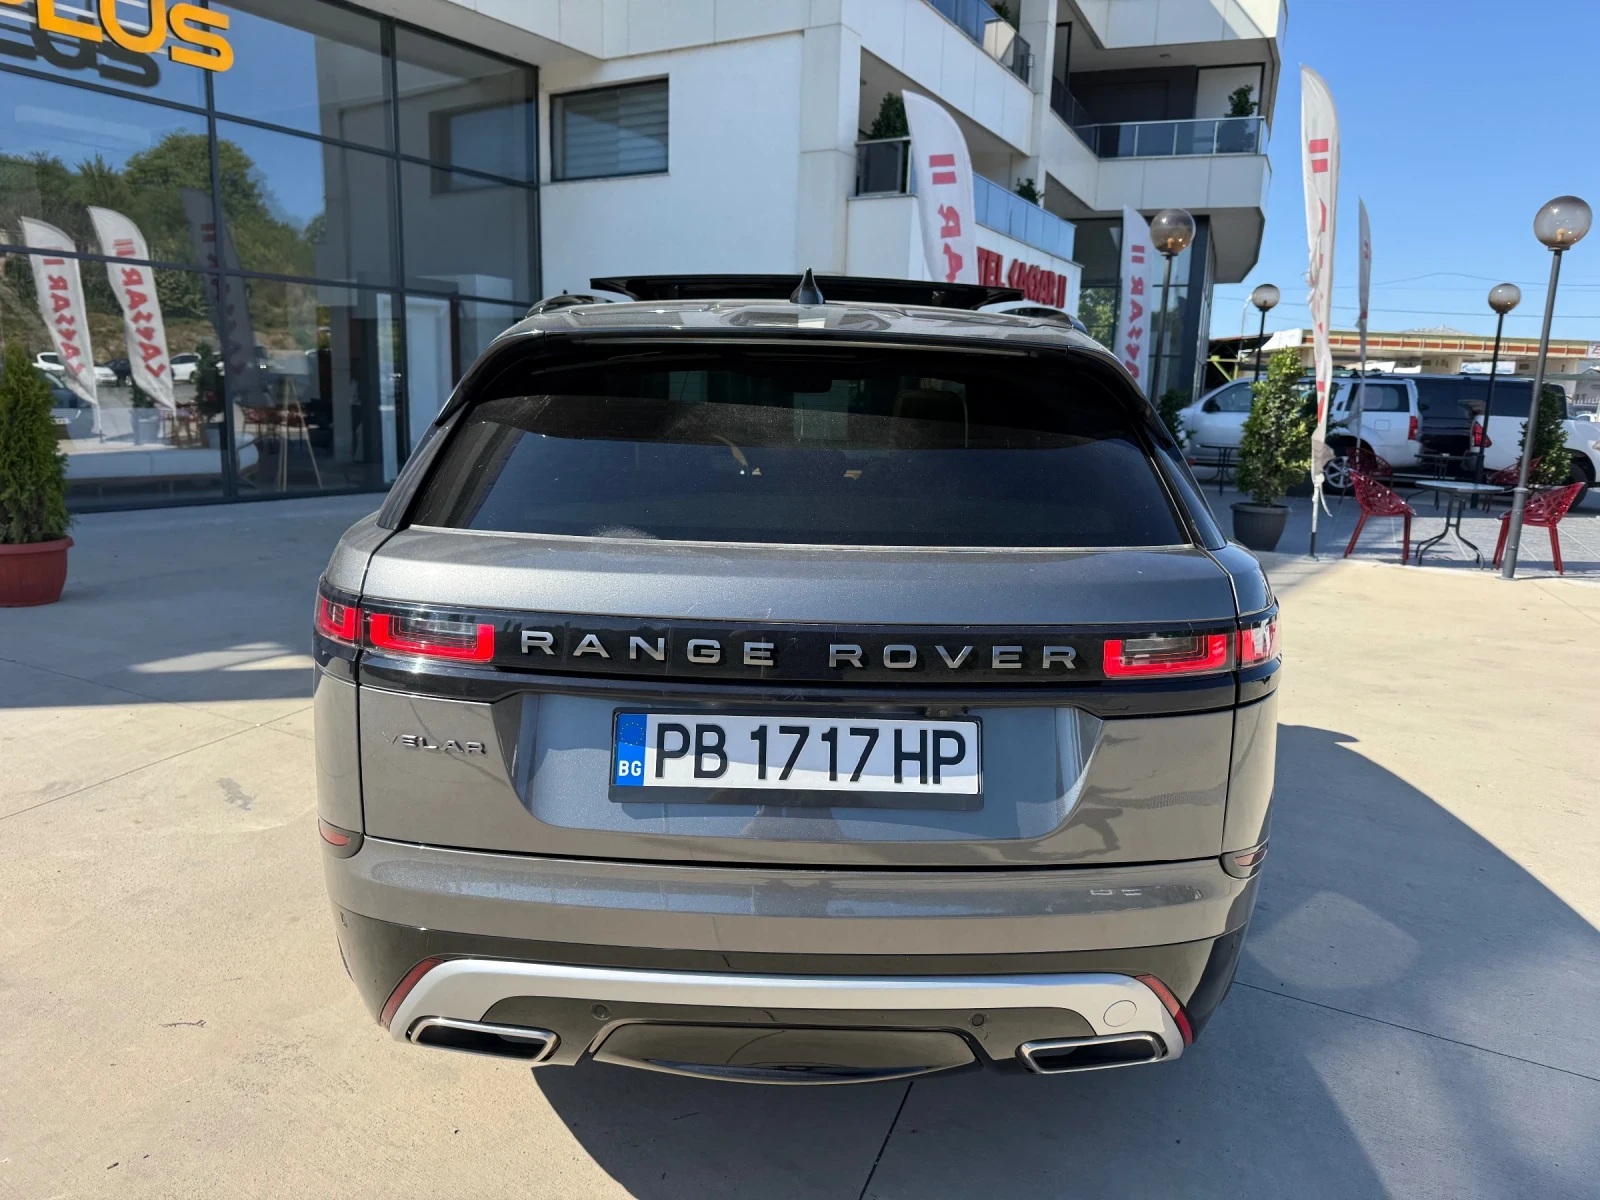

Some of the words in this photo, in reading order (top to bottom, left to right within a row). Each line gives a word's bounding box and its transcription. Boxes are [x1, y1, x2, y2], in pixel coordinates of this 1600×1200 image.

[0, 0, 234, 73] LUS
[976, 246, 1006, 288] TEL
[520, 629, 776, 666] RANGE
[829, 642, 1077, 670] ROVER
[381, 731, 487, 755] VELAR
[654, 722, 730, 780] PB
[749, 725, 880, 783] 1717
[893, 728, 967, 785] HP
[618, 759, 642, 777] BG
